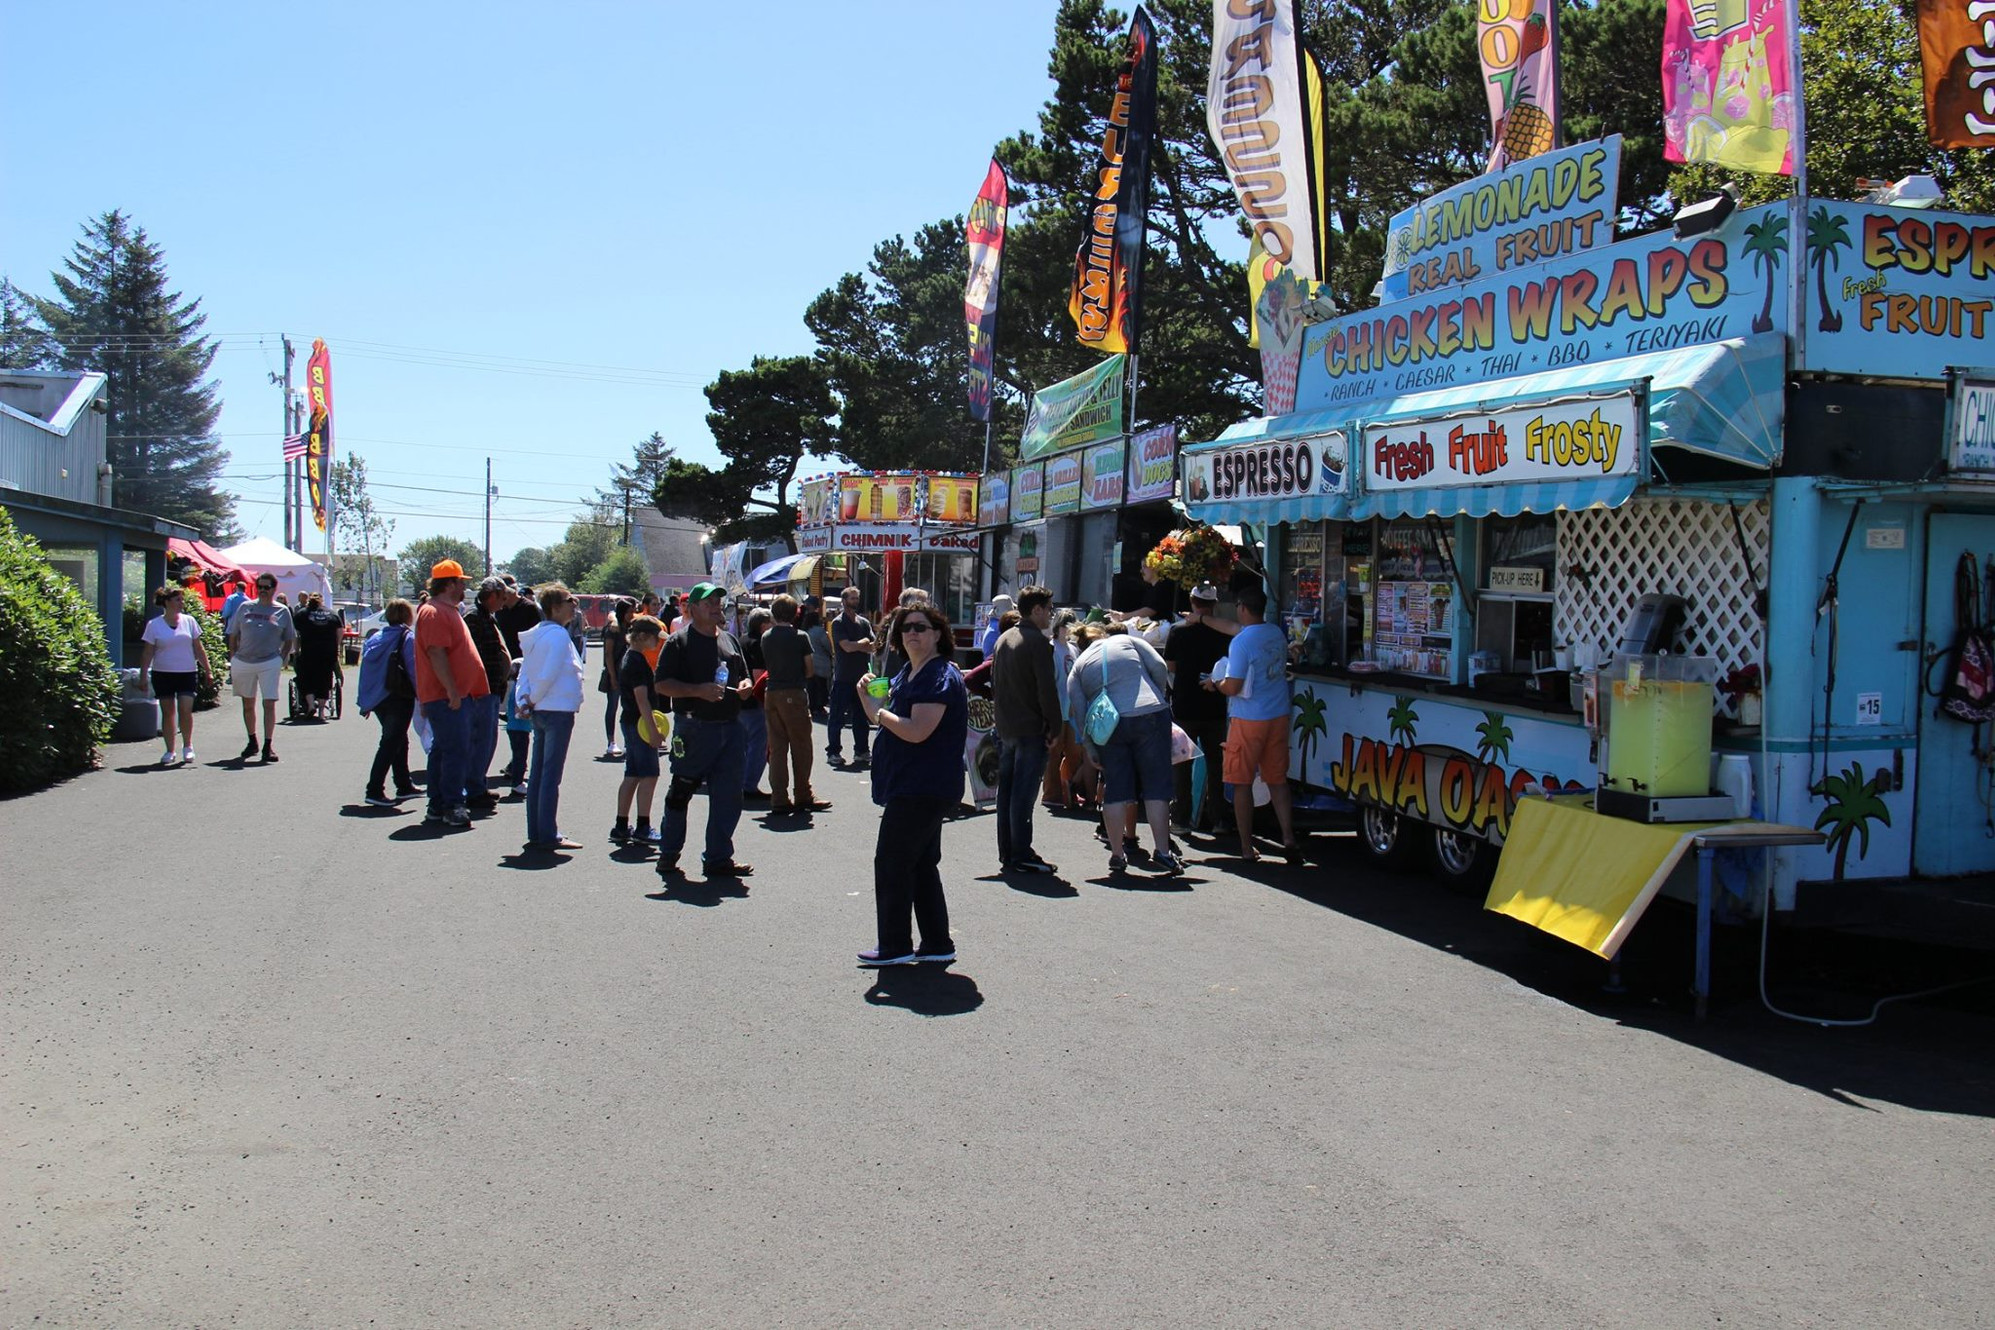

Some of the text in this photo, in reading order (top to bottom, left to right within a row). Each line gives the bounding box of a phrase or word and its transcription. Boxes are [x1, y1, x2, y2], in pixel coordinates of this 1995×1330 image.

[1411, 149, 1606, 254] LEMONADE
[1408, 210, 1603, 295] REAL FRUIT
[1325, 238, 1728, 378] CHICKEN WRAPS
[1842, 269, 1887, 301] Fresh
[1859, 291, 1993, 339] FRUIT
[1329, 314, 1728, 402] RANCH CAESAR THAI BBQ TERIYAKI
[1071, 404, 1113, 431] SANDWICH
[1143, 433, 1174, 461] CORN
[1212, 441, 1313, 500] ESPRESSO
[1374, 407, 1622, 482] Fresh Fruit Frosty
[1142, 459, 1173, 487] DOGS
[1491, 571, 1534, 586] PICK-UP HERE
[1867, 699, 1880, 715] 15
[1330, 732, 1429, 820] JAVA
